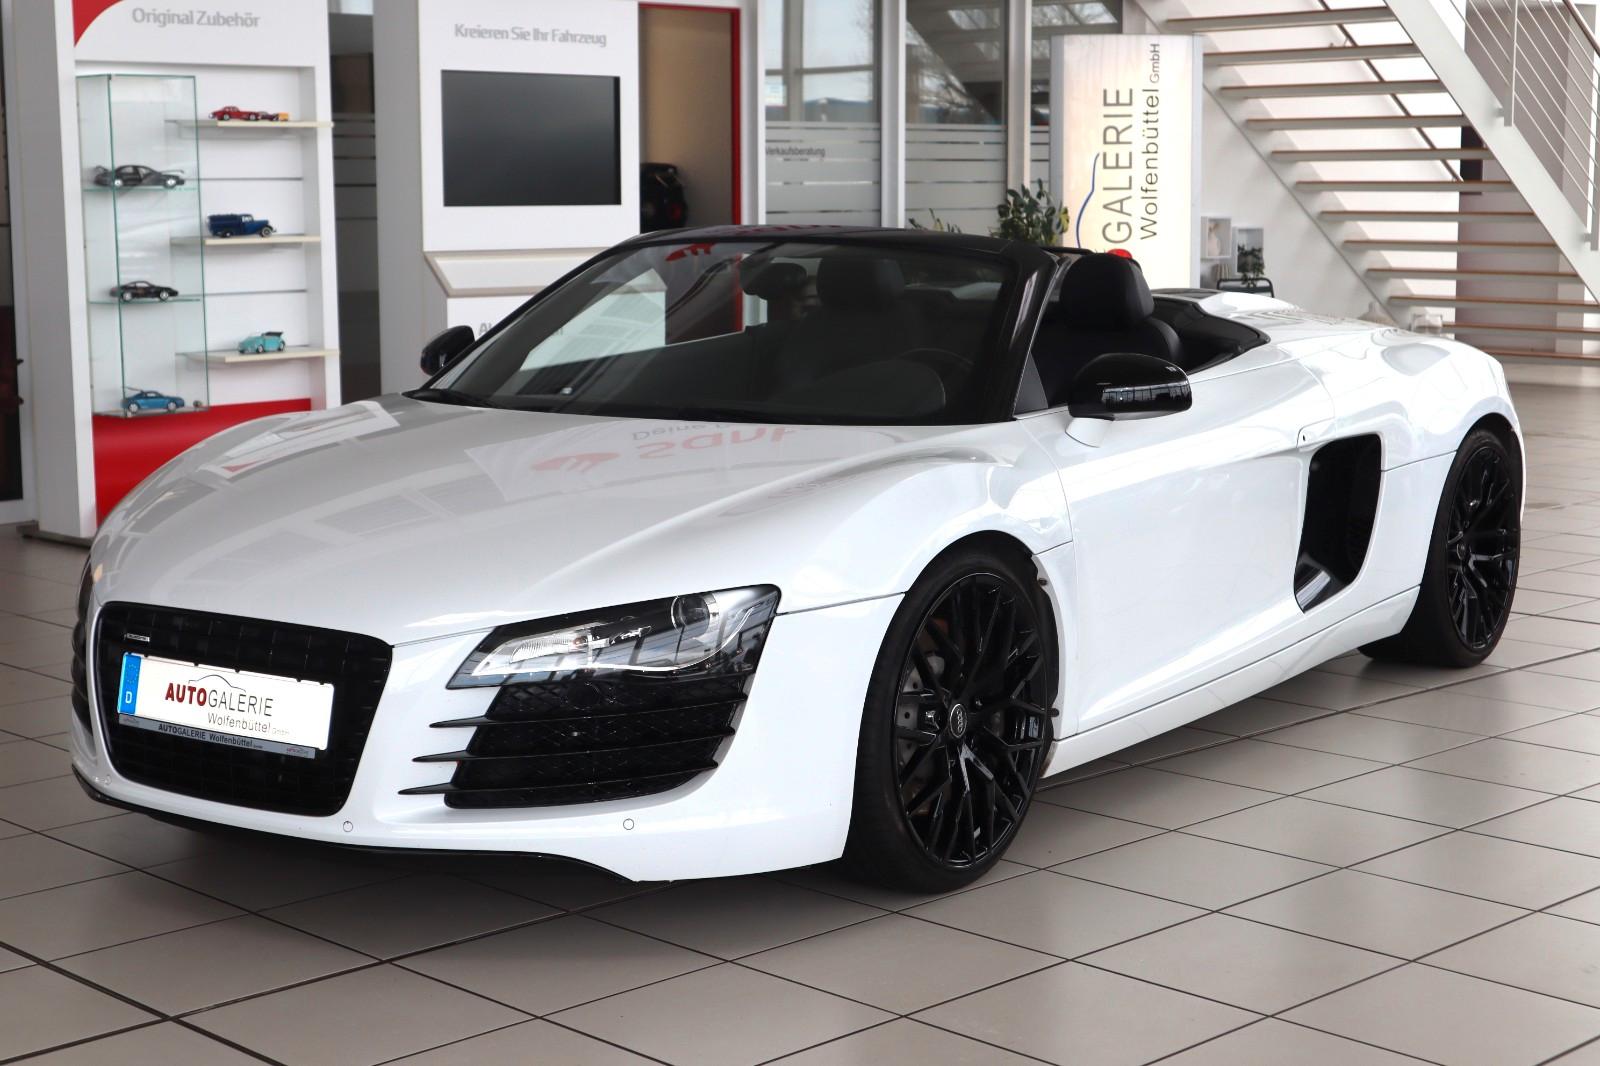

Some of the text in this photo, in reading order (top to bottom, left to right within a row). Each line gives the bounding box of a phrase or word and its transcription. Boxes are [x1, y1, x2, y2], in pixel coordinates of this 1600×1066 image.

[131, 7, 260, 28] Original Zubehör
[454, 23, 607, 48] Kreieren Sie Ihr Fahrzeug
[1140, 43, 1160, 240] Wolfenbüttel GmbH
[1101, 88, 1133, 259] GALERIE
[125, 690, 133, 704] D
[165, 682, 274, 717] AUTOGALERIE
[158, 723, 206, 740] AUTOGALERIE
[209, 732, 253, 748] Wolfenbüttel
[208, 712, 271, 734] Wolfenbüttel
